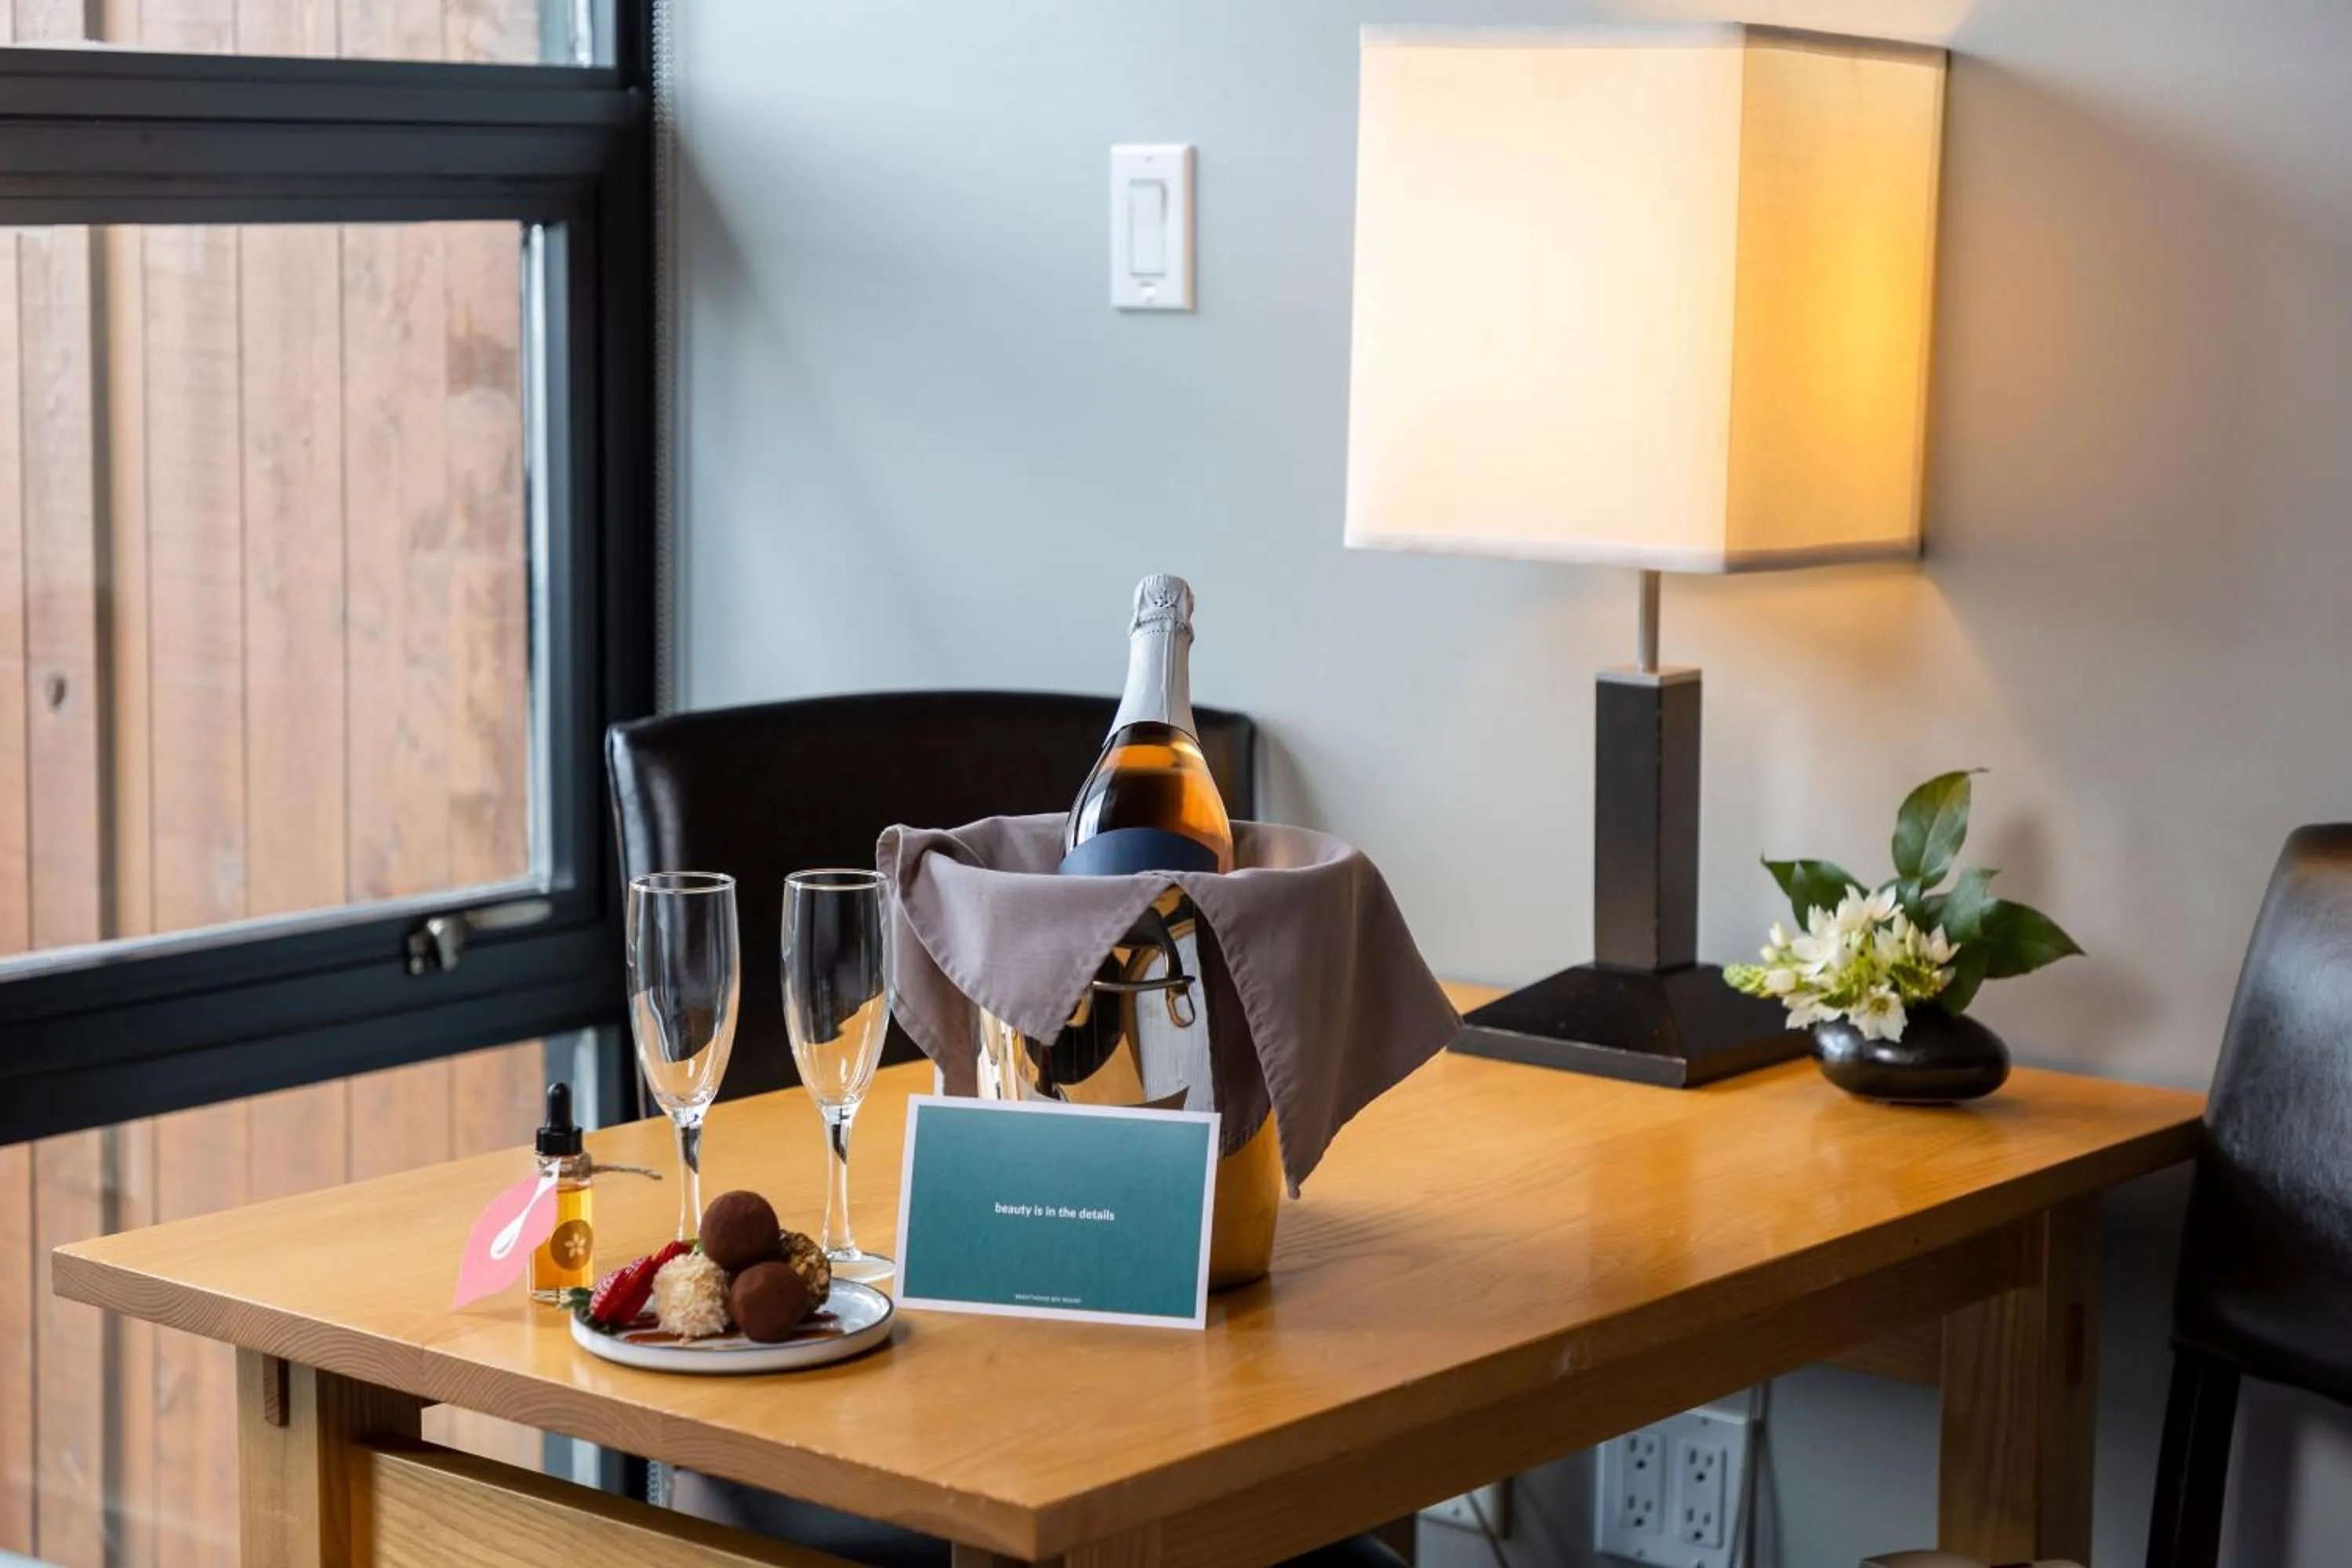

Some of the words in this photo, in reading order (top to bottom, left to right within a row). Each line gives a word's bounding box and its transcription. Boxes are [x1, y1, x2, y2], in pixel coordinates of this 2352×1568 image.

[995, 1202, 1033, 1217] beauty
[1035, 1204, 1043, 1217] is
[1046, 1206, 1056, 1217] in
[1059, 1207, 1076, 1218] the
[1079, 1208, 1115, 1221] details
